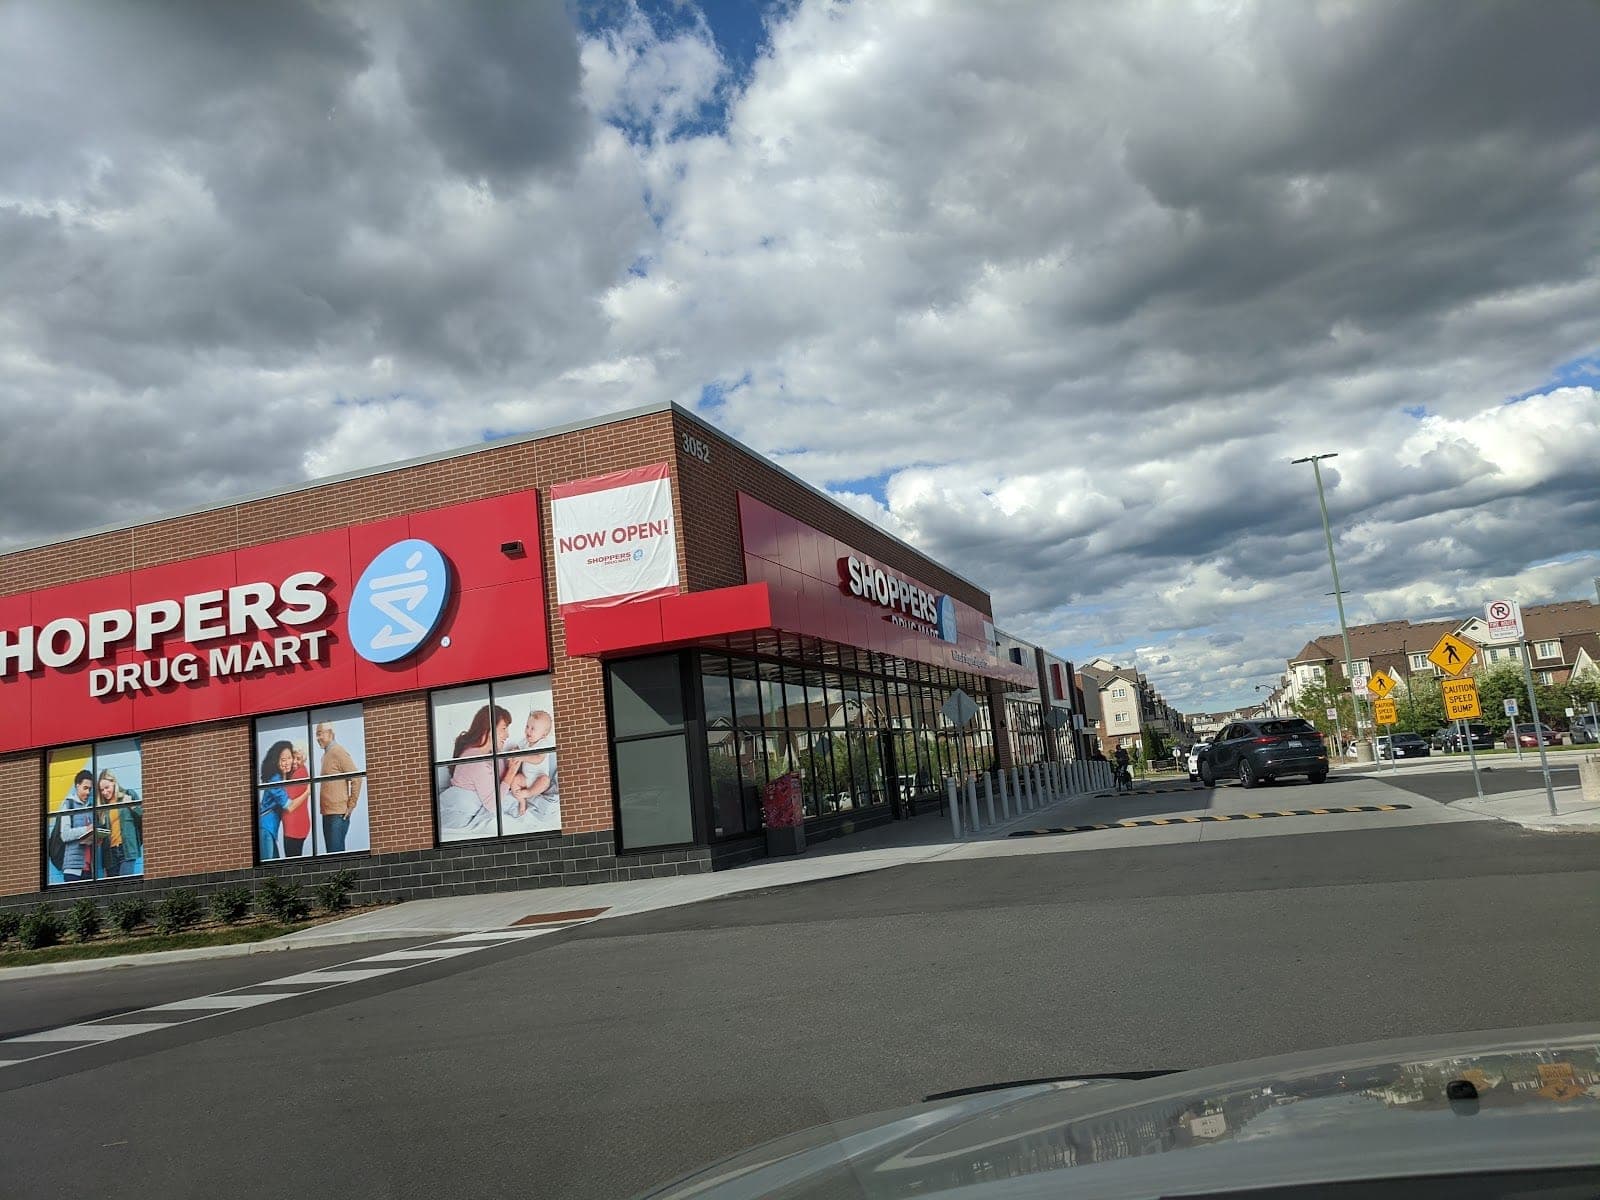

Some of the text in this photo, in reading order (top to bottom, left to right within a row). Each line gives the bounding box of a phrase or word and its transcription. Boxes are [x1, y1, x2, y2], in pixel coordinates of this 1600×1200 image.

[682, 433, 711, 464] 3052
[559, 519, 669, 554] NOW OPEN!
[586, 551, 632, 565] SHOPPERS
[847, 555, 938, 625] SHOPPERS
[0, 571, 328, 677] HOPPERS
[88, 630, 329, 698] DRUG MART
[1443, 683, 1475, 695] CAUTION
[1448, 694, 1473, 704] SPEED
[1452, 704, 1474, 714] BUMP
